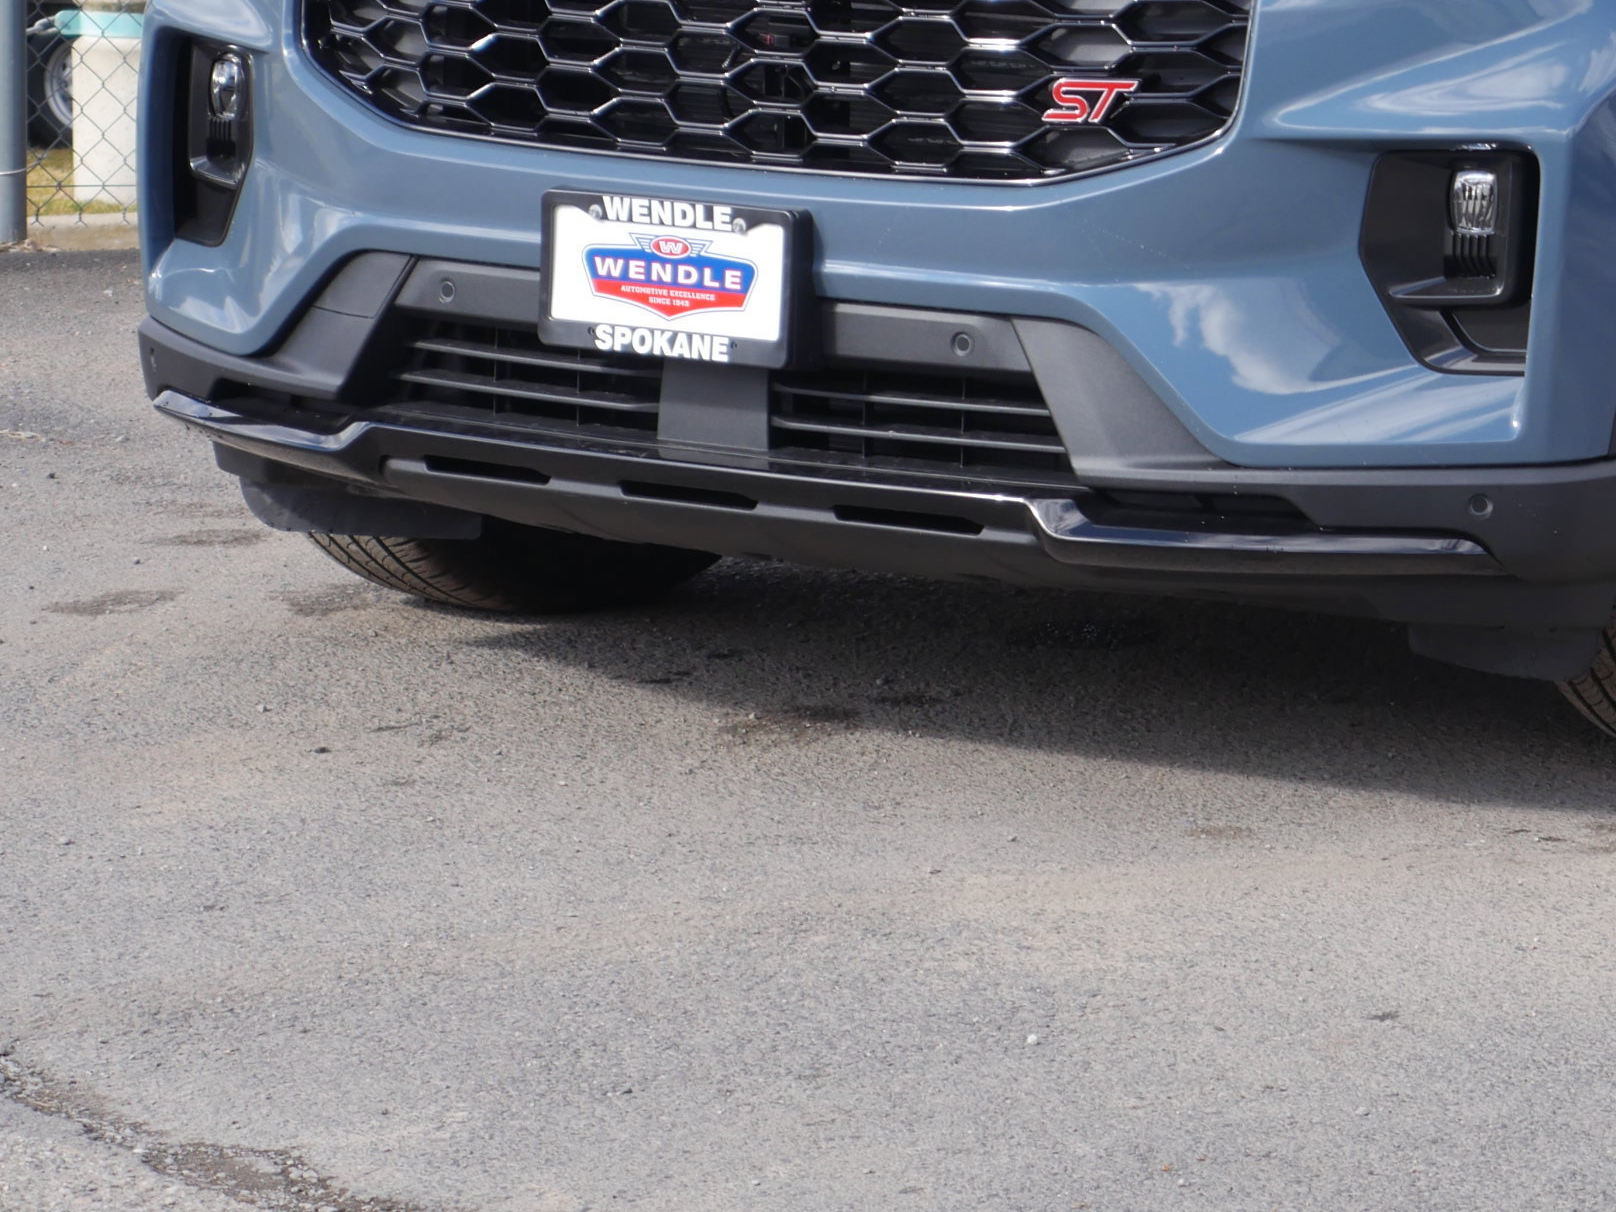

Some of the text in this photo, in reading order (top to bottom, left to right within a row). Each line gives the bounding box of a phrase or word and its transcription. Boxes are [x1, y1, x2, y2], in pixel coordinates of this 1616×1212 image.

[1042, 77, 1138, 123] ST
[602, 195, 733, 232] WENDLE
[594, 256, 742, 290] WENDLE
[621, 285, 716, 301] AUTOMOTIVE EXCELLENCE
[649, 296, 671, 306] SINCE
[594, 324, 730, 362] SPOKANE
